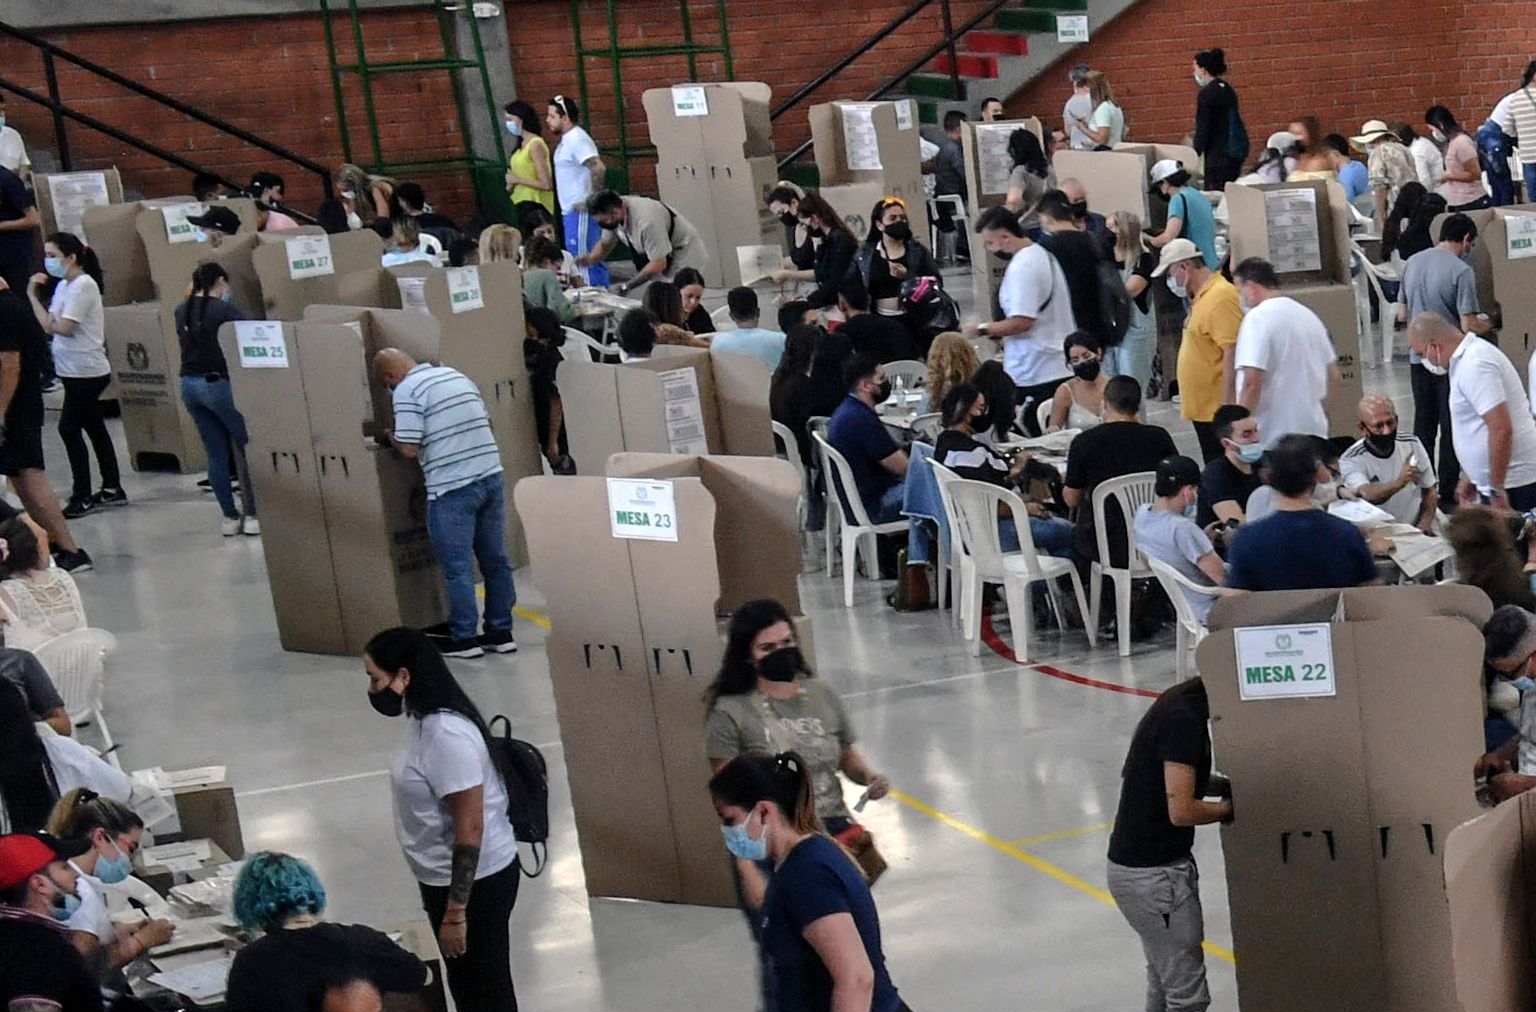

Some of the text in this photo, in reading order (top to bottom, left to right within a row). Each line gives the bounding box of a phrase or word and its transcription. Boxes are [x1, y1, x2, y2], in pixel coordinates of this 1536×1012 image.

[170, 224, 190, 235] MESA
[1511, 238, 1533, 249] MESA
[292, 258, 315, 270] MESA
[453, 291, 469, 303] MESA
[243, 346, 283, 357] MESA 25
[616, 511, 671, 528] MESA 23
[1246, 664, 1327, 684] MESA 22
